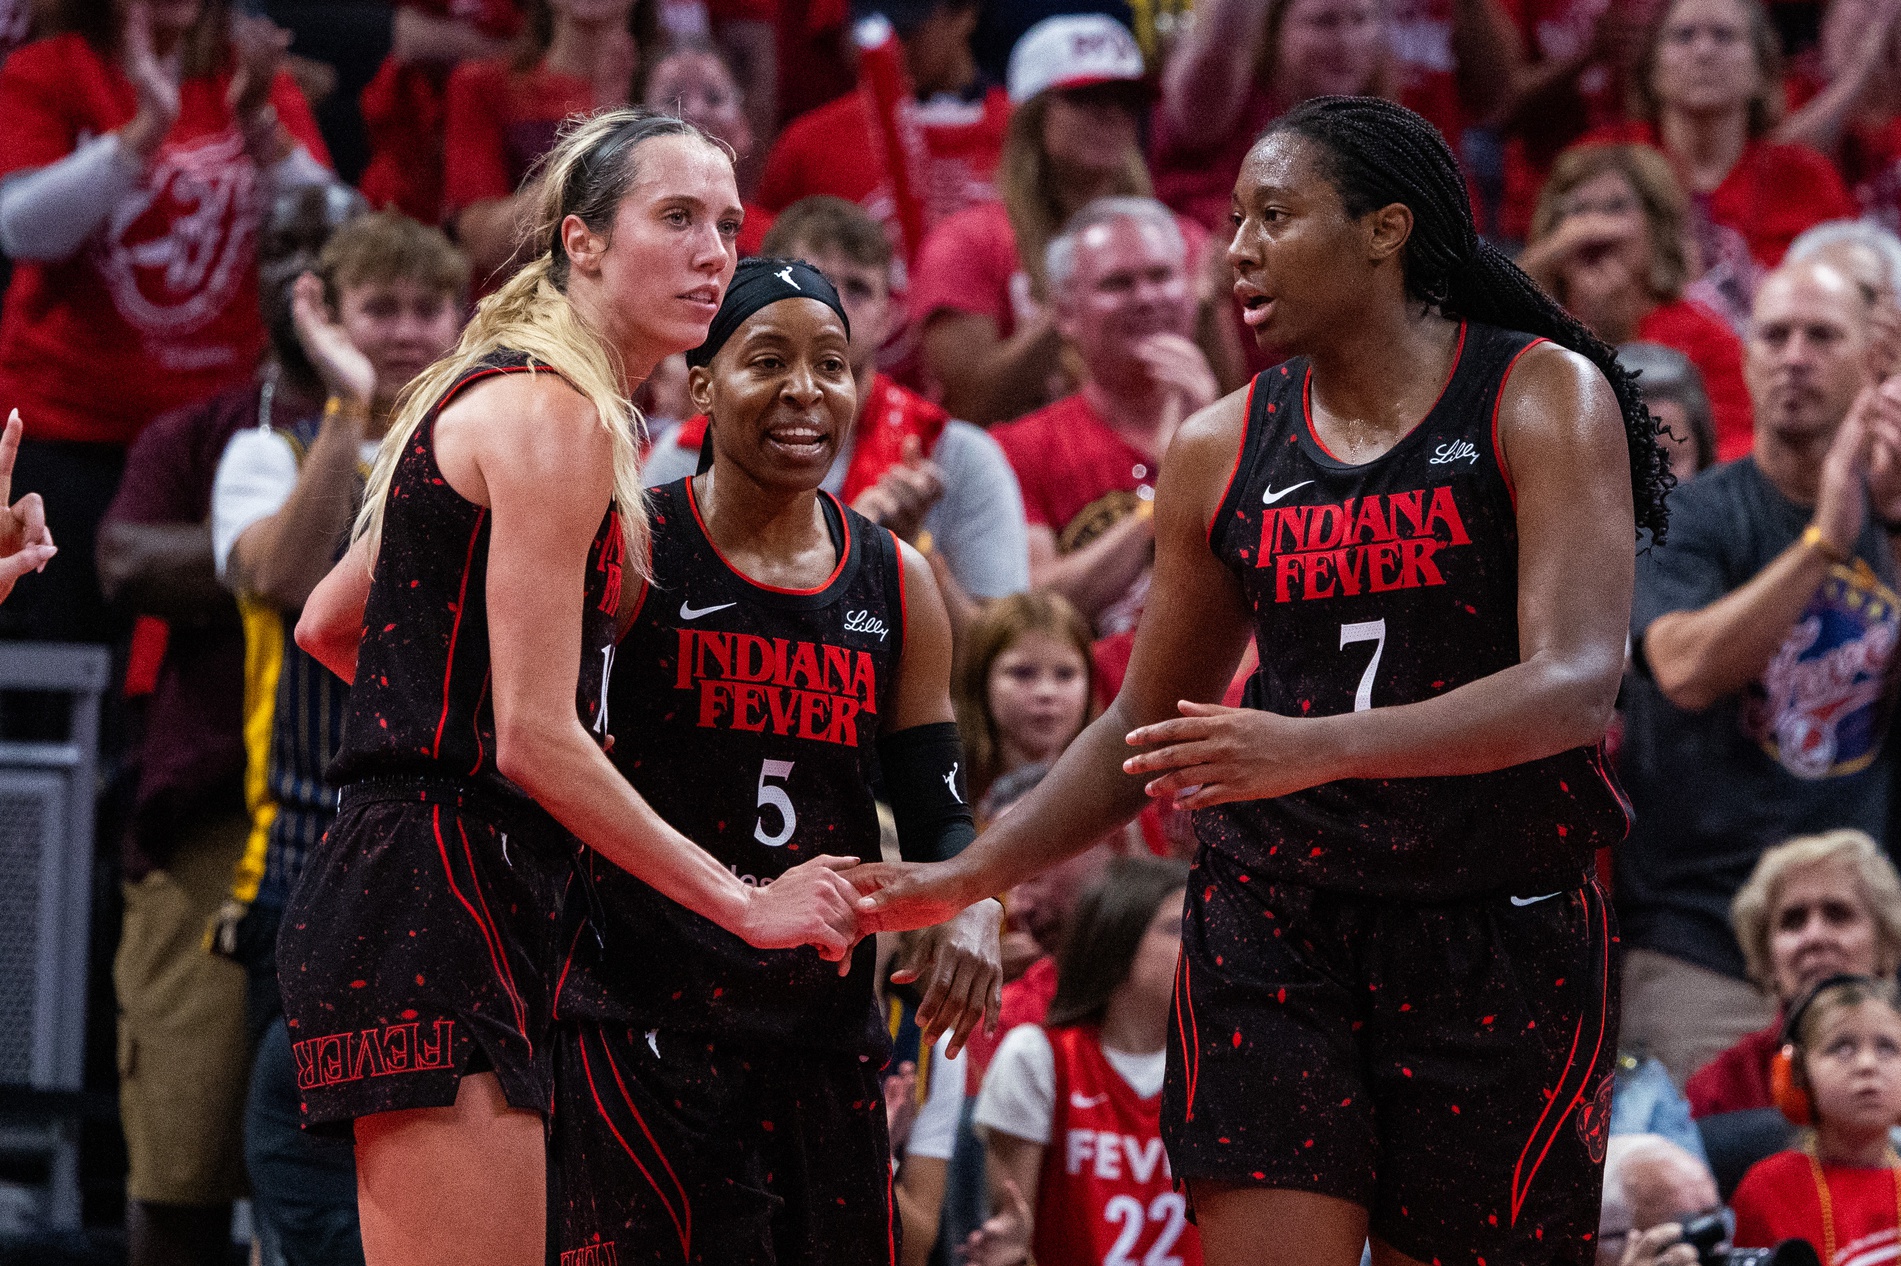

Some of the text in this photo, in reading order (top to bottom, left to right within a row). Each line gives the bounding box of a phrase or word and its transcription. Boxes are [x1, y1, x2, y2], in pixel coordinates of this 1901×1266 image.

[1429, 438, 1480, 465] Lilly
[1255, 486, 1473, 569] INDIANA
[1275, 538, 1447, 603] FEVER
[843, 609, 889, 642] Lilly
[674, 628, 877, 714] INDIANA
[1339, 617, 1386, 711] 7
[697, 679, 859, 748] FEVER
[753, 758, 797, 847] 5
[292, 1019, 455, 1090] FEVER
[1066, 1129, 1172, 1184] FEV
[1103, 1192, 1187, 1266] 22
